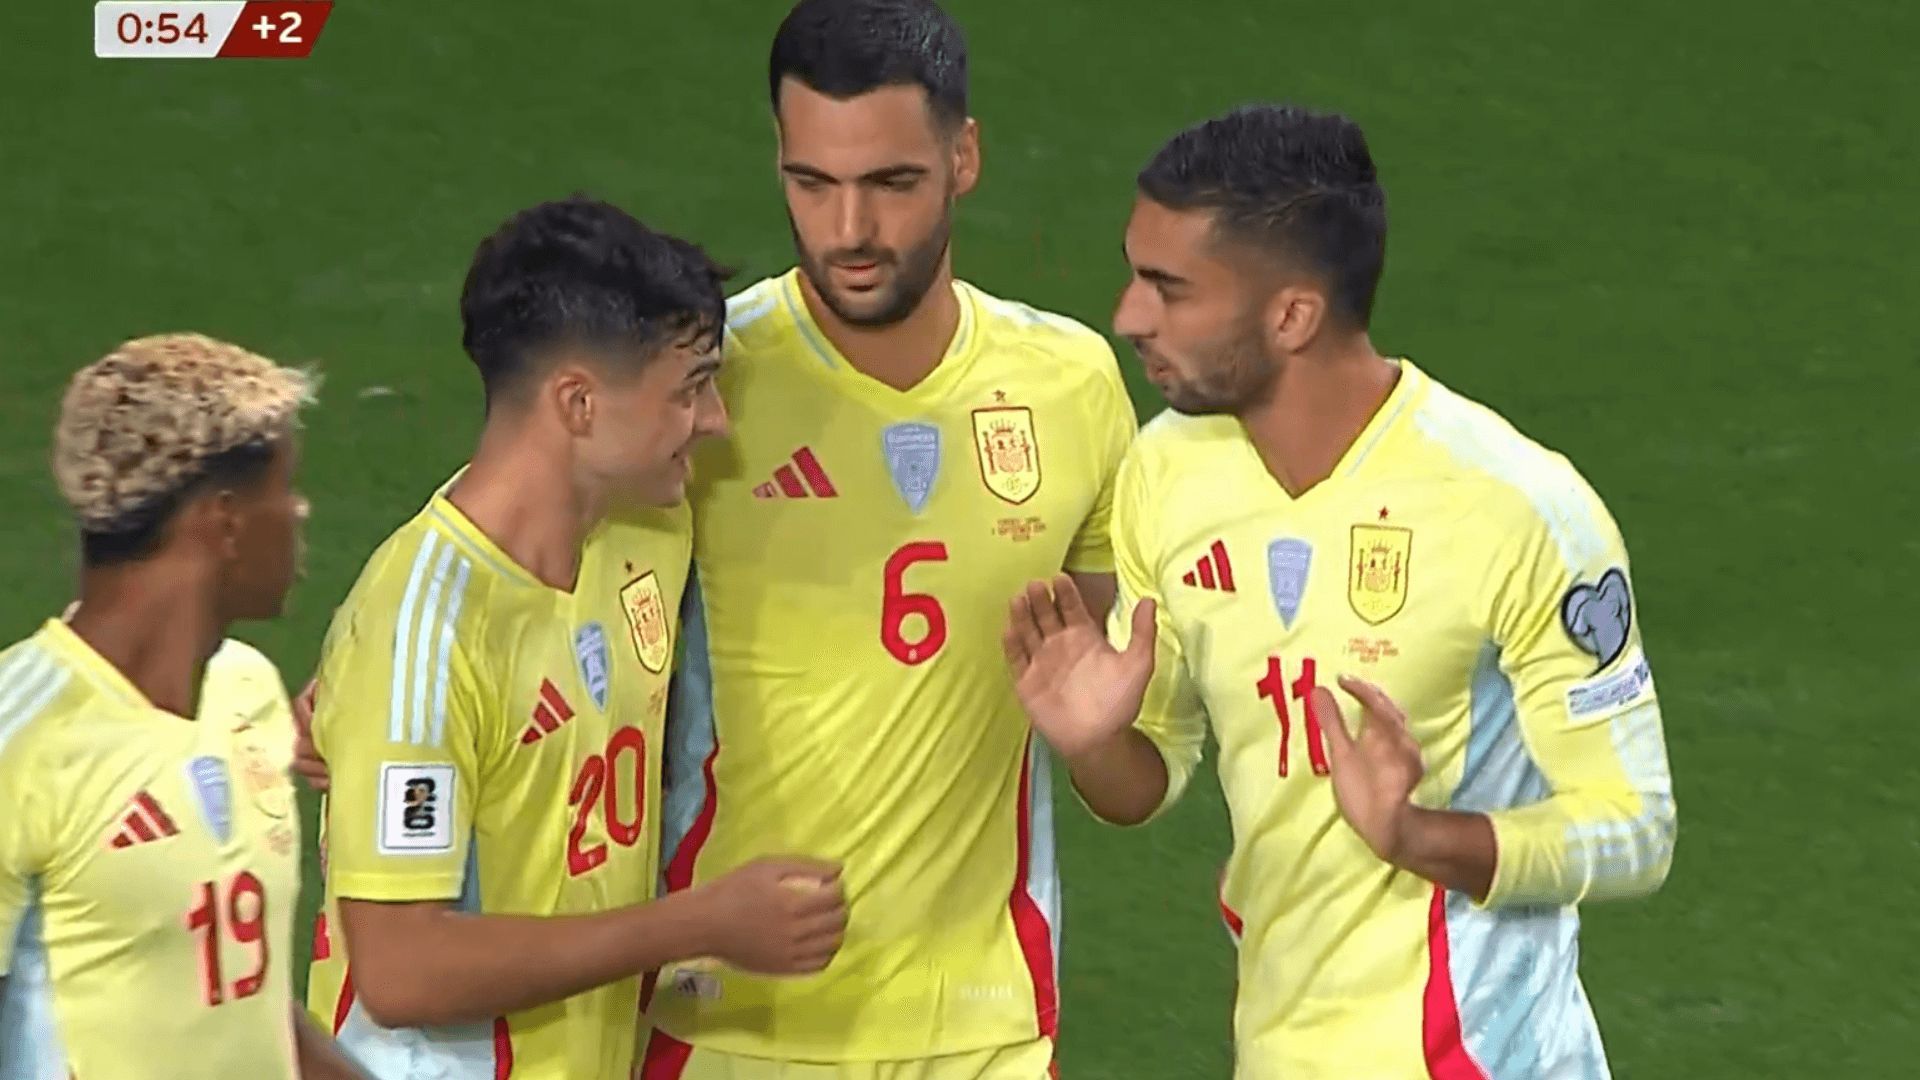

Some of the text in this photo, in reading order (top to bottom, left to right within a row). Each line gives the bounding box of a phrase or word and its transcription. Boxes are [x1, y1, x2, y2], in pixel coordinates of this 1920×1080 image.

[881, 541, 948, 665] 6
[1256, 656, 1330, 778] 11
[566, 725, 646, 877] 20
[186, 870, 269, 1006] 19
